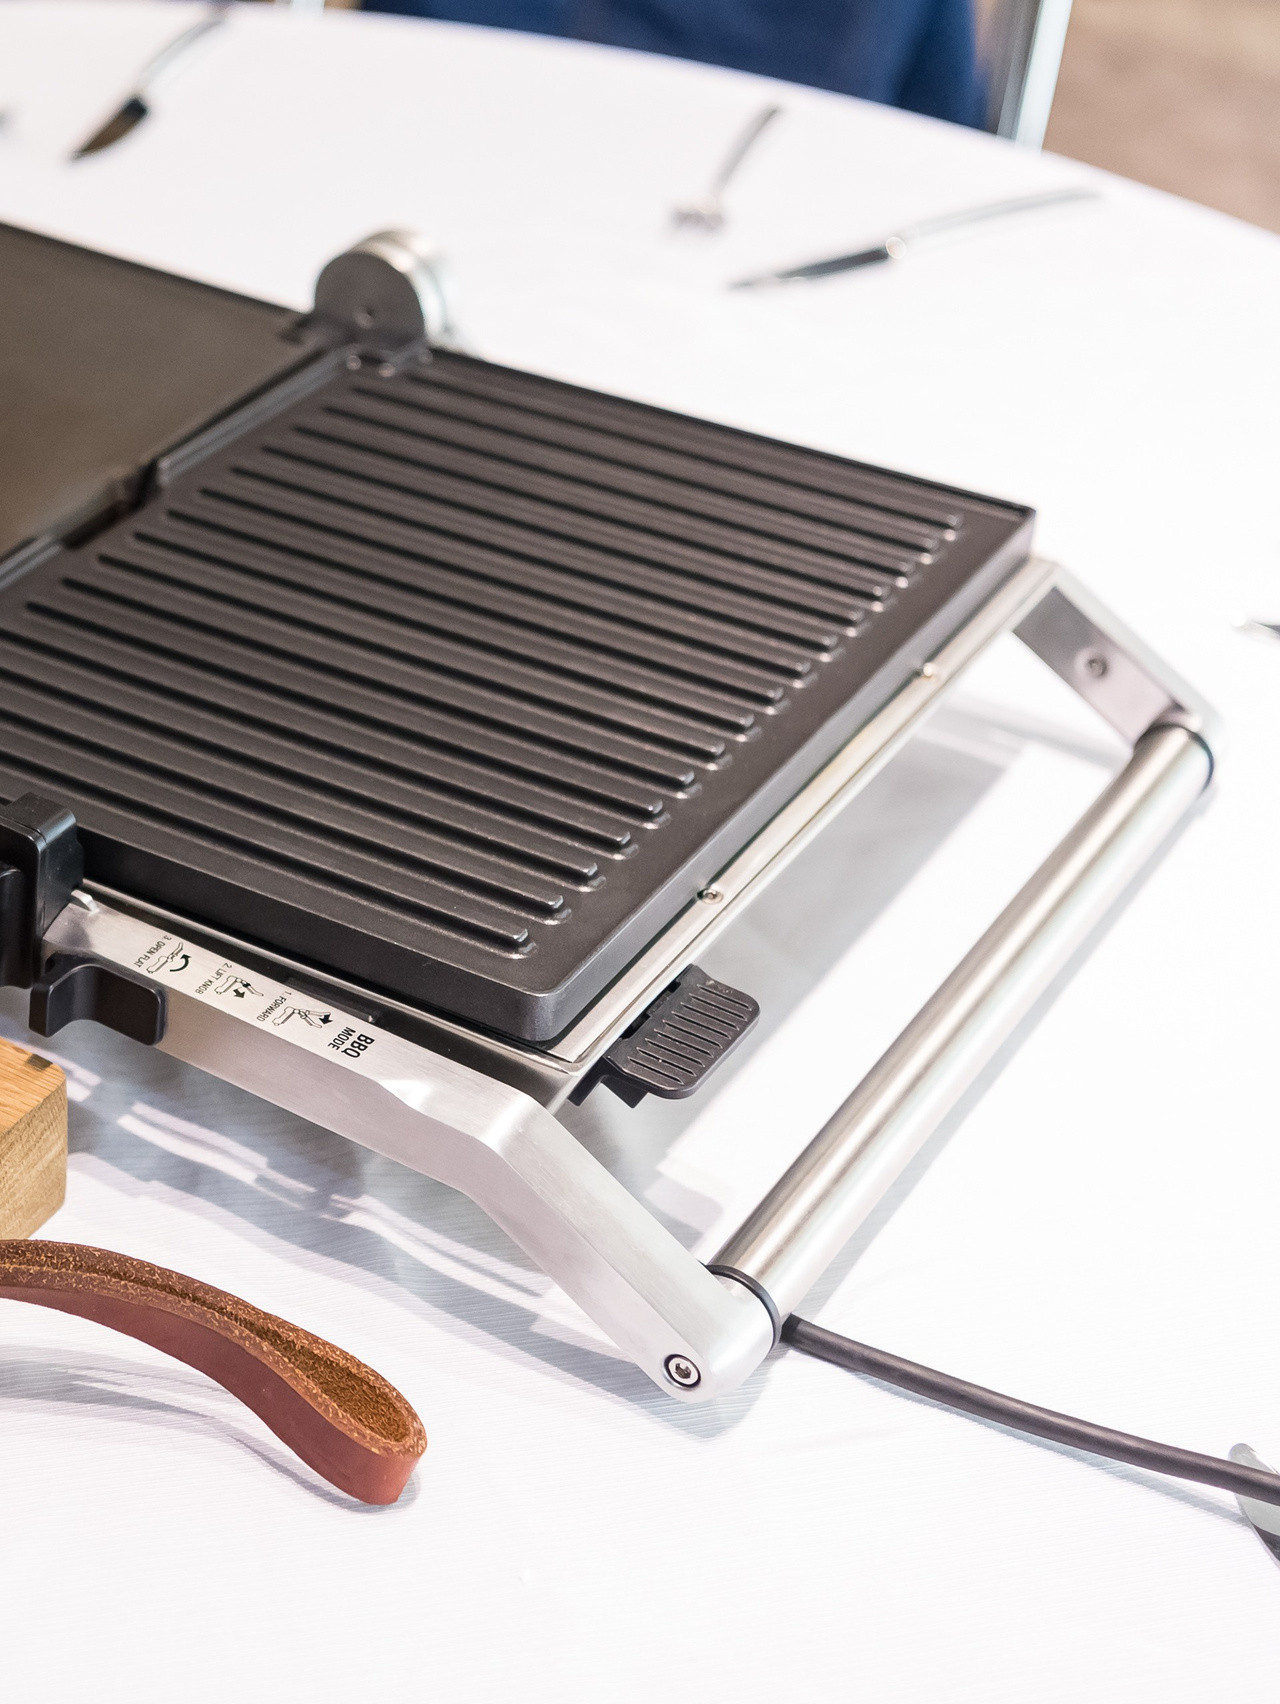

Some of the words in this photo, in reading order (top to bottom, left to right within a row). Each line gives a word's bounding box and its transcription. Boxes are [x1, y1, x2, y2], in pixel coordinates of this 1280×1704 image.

[146, 940, 166, 955] OPEN
[133, 953, 151, 968] FLAT
[211, 967, 227, 981] LIFT
[194, 978, 214, 995] KNOB
[256, 995, 287, 1022] FORWARD
[327, 1026, 357, 1051] MODE
[340, 1033, 376, 1059] BBQ
